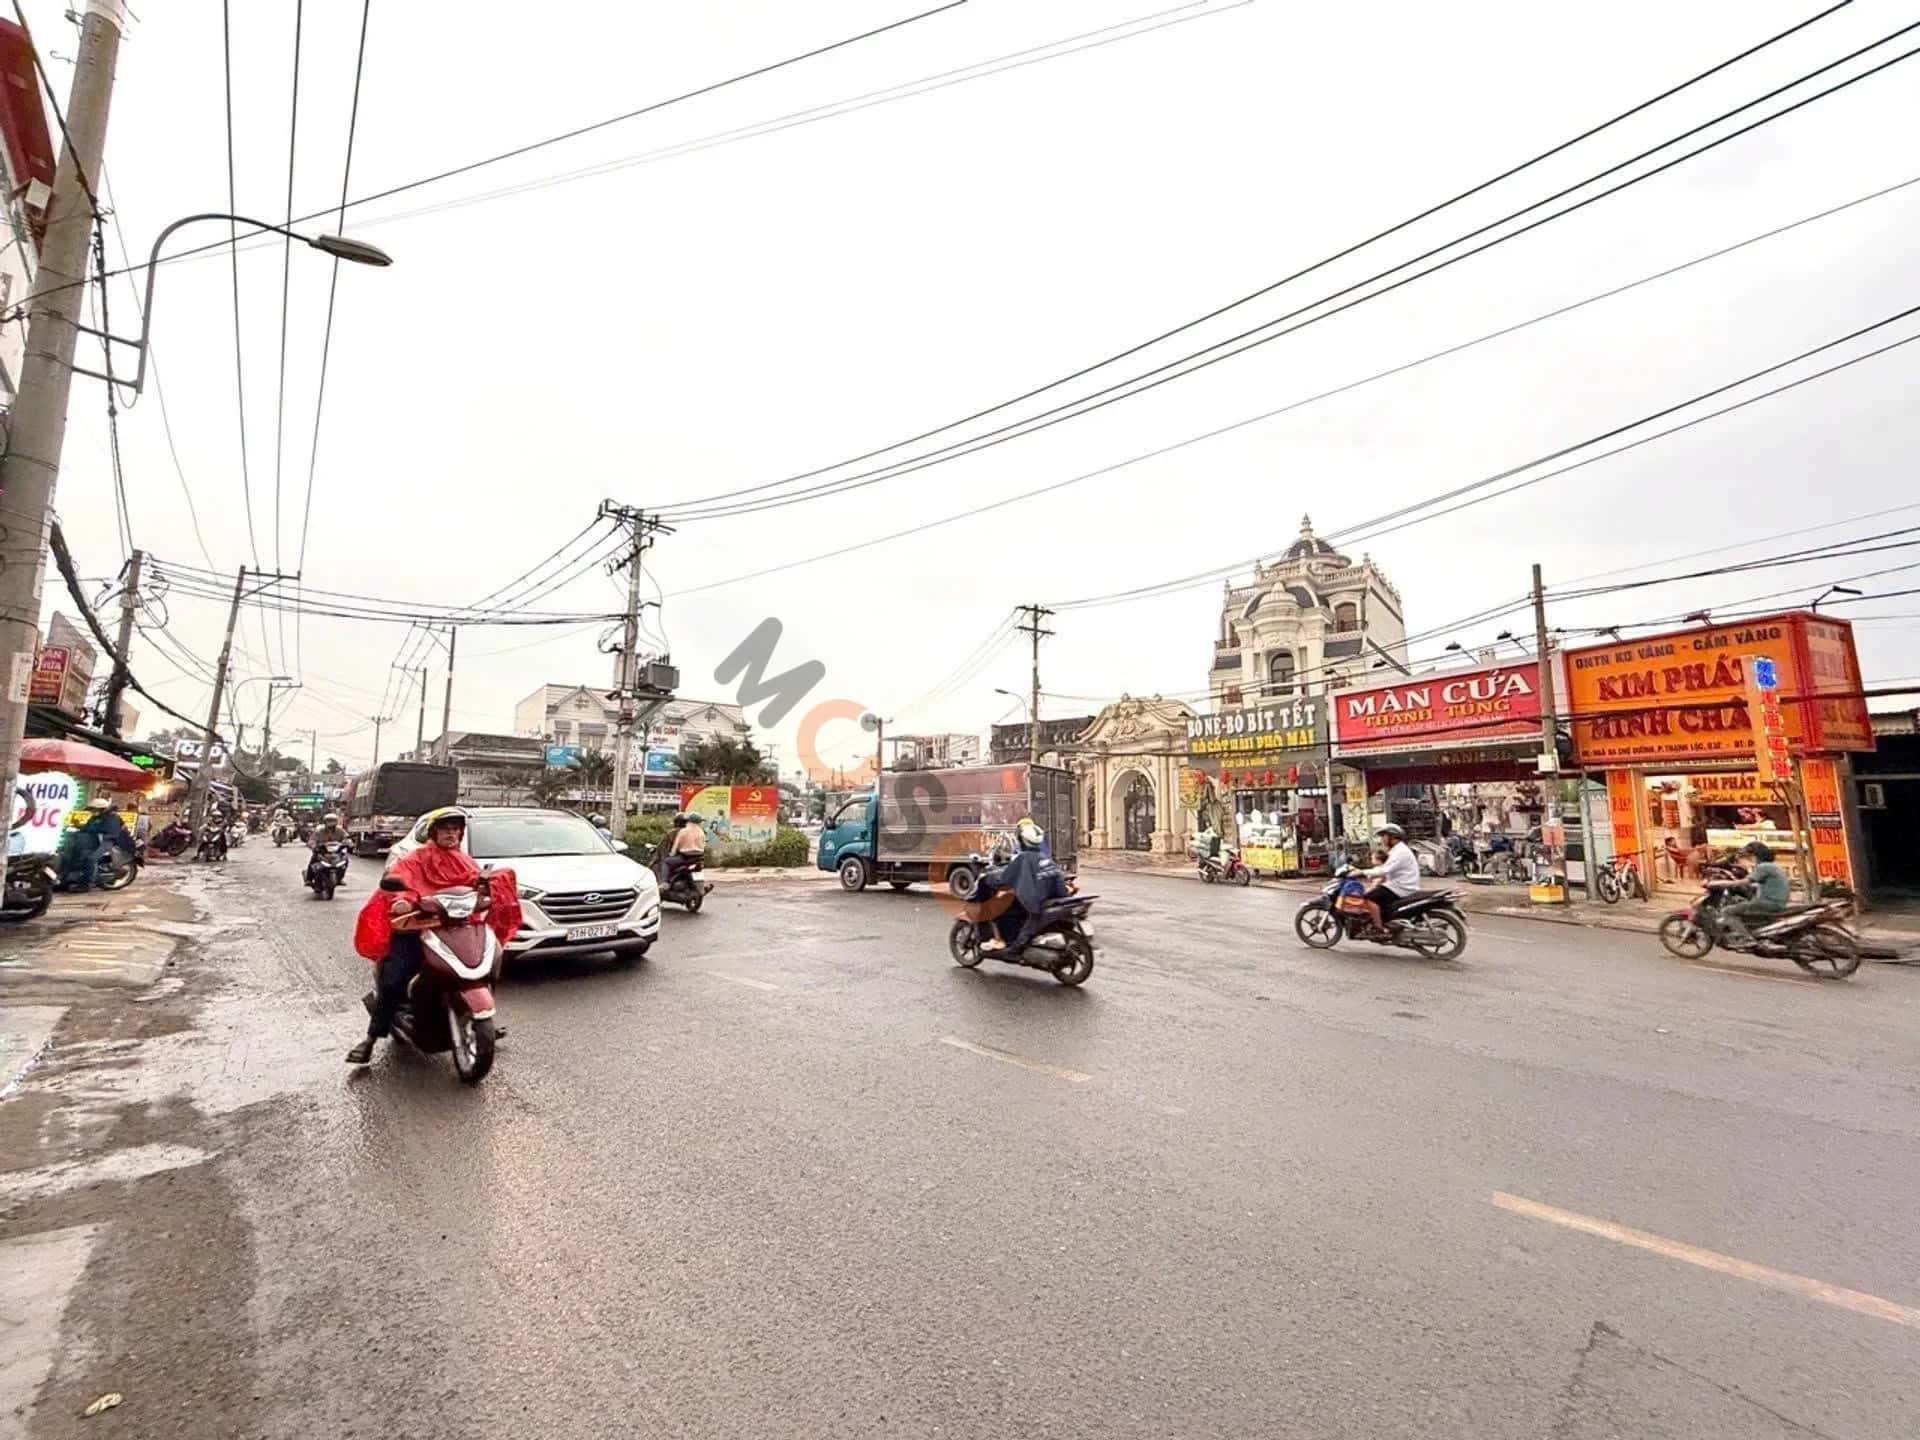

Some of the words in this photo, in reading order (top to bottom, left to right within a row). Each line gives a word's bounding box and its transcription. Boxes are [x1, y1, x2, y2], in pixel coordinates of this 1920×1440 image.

[1637, 643, 1675, 660] VÀNG
[1734, 626, 1781, 644] VÀNG
[1348, 689, 1430, 718] MÀN
[1443, 670, 1532, 704] CỬA
[1598, 670, 1659, 700] KIM
[1247, 707, 1275, 732] BÍT
[1280, 699, 1316, 728] TẾT
[1364, 709, 1434, 729] THANH
[1590, 709, 1673, 740] MINH
[1679, 697, 1753, 734] CHÂ
[1692, 776, 1719, 791] KIM
[1720, 773, 1757, 790] PHÁT
